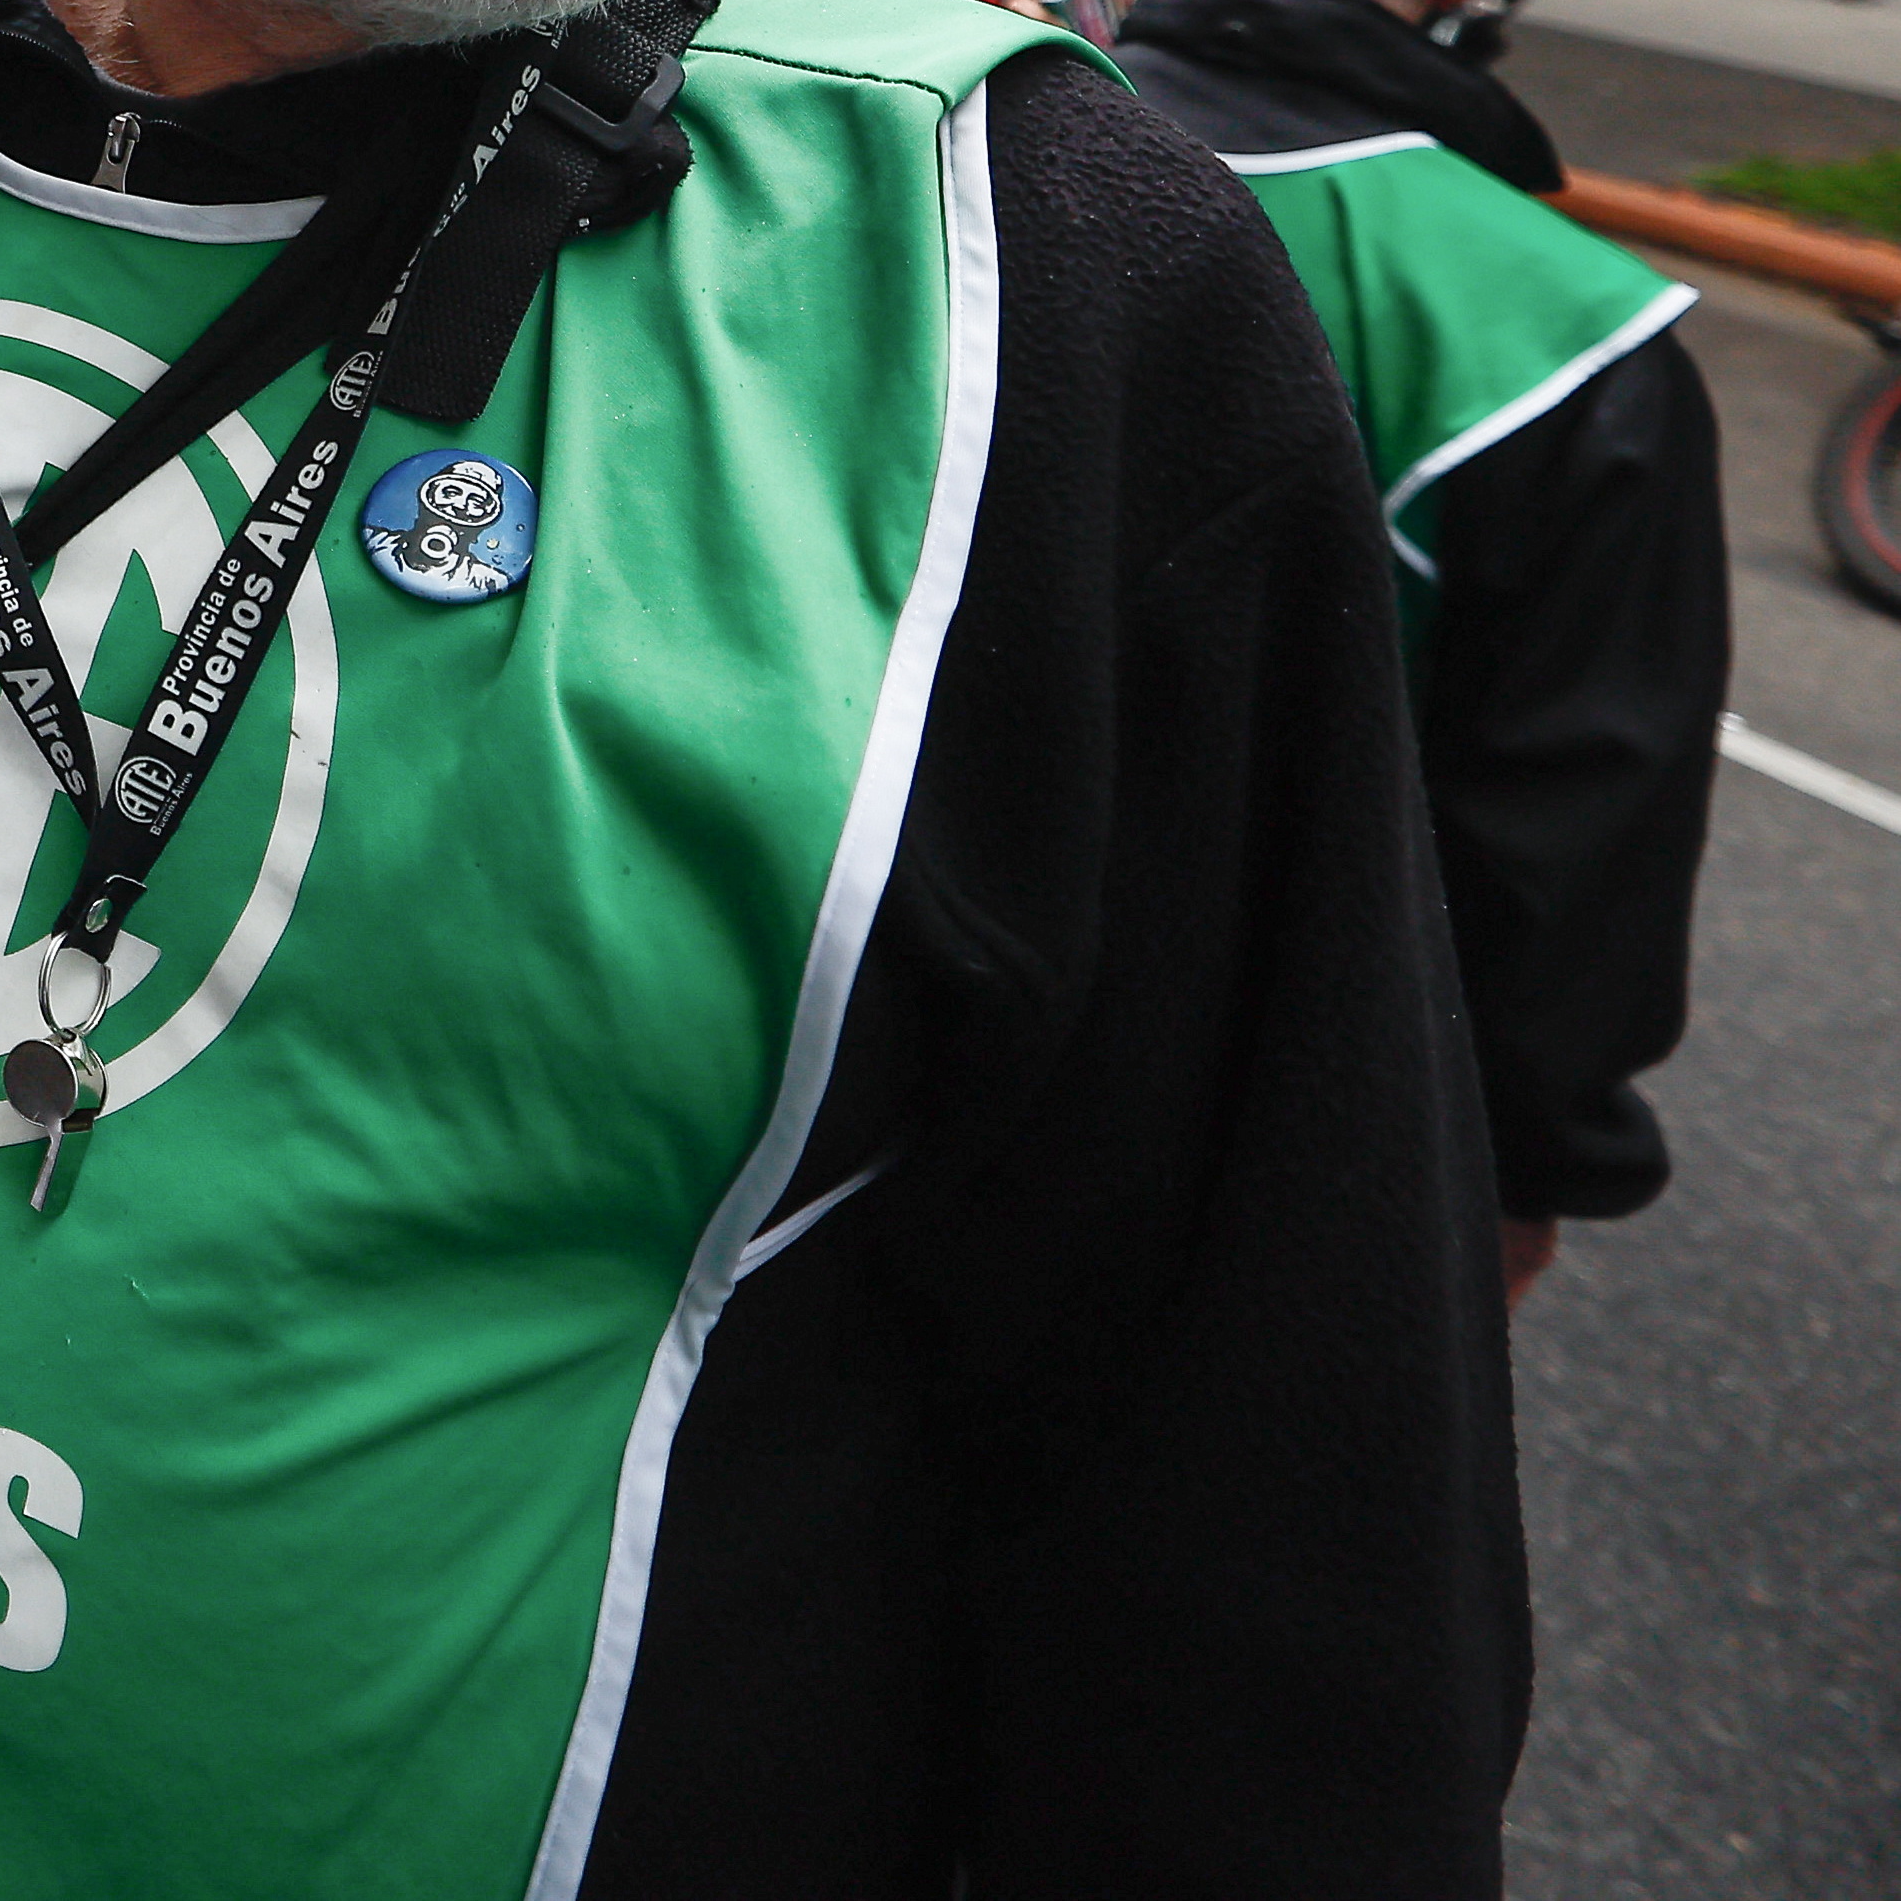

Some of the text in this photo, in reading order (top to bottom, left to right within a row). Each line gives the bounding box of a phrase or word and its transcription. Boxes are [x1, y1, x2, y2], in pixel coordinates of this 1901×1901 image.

[471, 63, 542, 185] Aires
[334, 357, 373, 406] ATE
[11, 615, 35, 648] de
[147, 439, 340, 758] Buenos Aires
[161, 557, 242, 696] Provincia de
[1, 666, 88, 798] Aires
[118, 760, 173, 818] ATE
[149, 770, 194, 837] Buenos Aires
